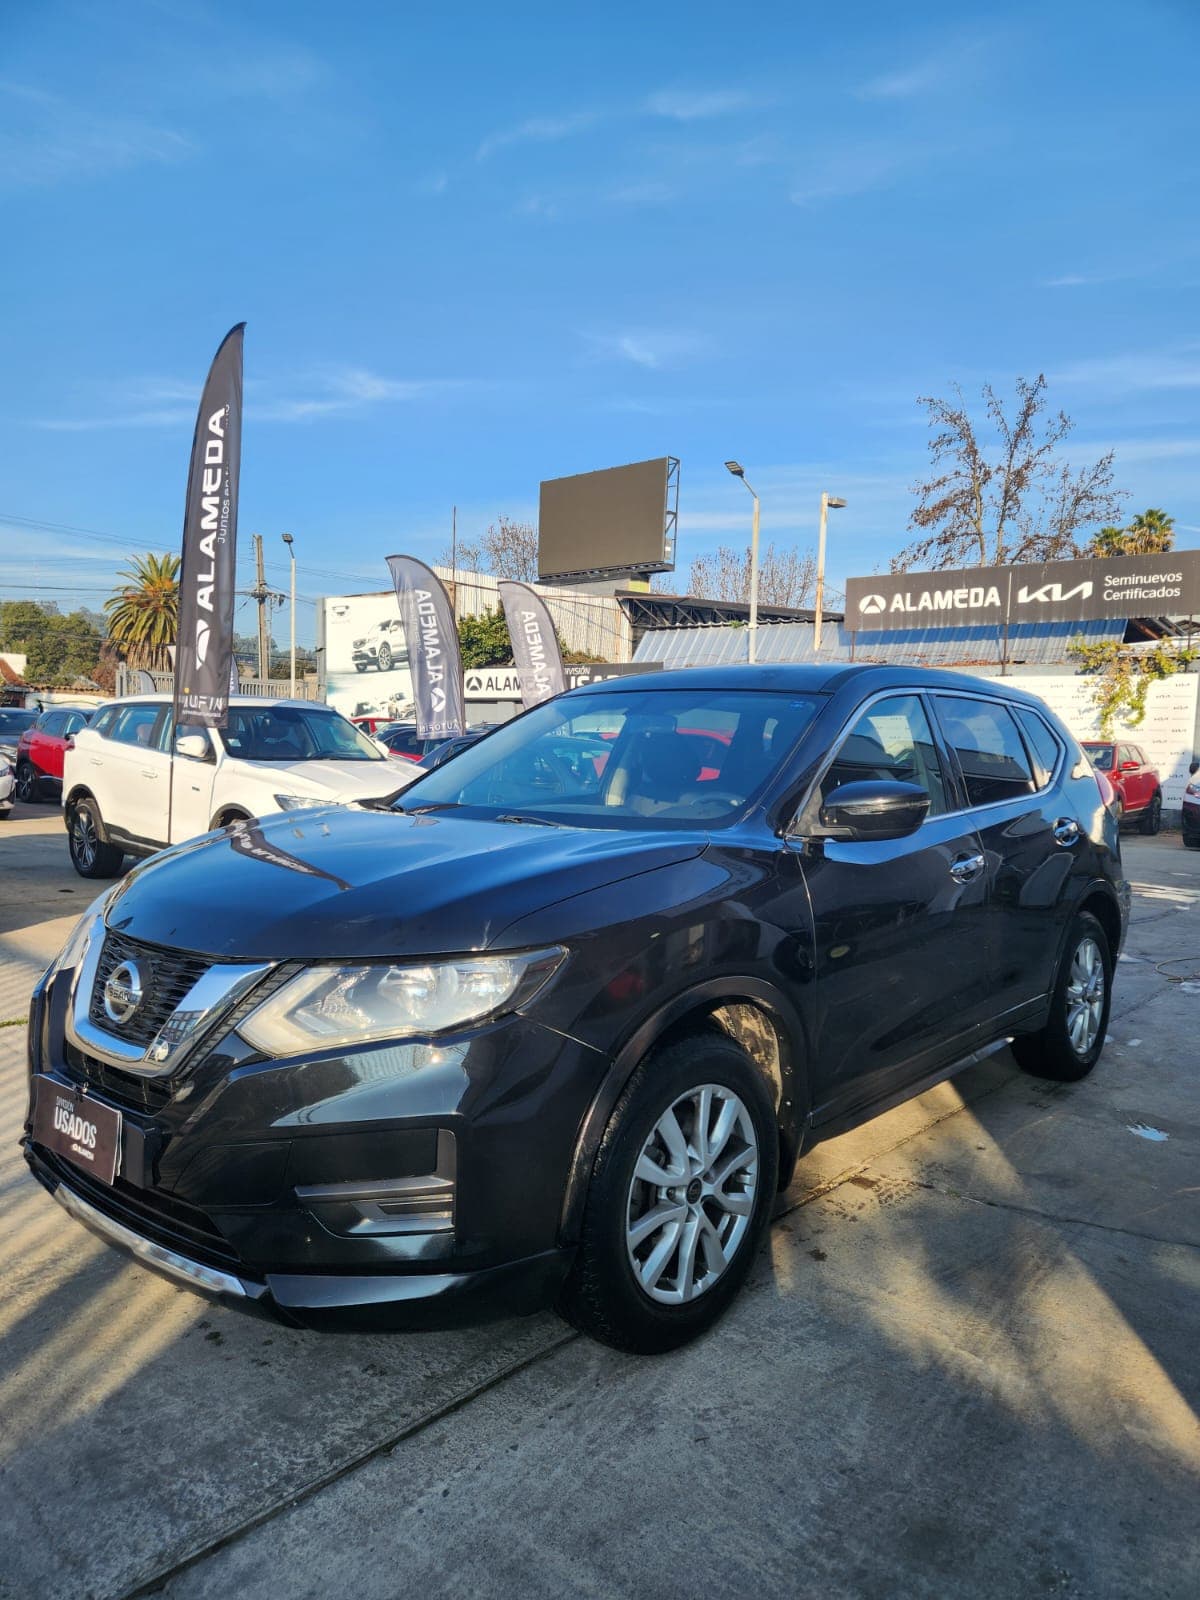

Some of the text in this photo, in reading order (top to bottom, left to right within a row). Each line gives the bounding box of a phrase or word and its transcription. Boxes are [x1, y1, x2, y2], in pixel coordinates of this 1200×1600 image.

[197, 408, 225, 612] ALAMEDA
[1104, 572, 1183, 587] Seminuevos
[889, 586, 1002, 613] ALAMEDA
[1018, 581, 1094, 604] KIA
[1103, 587, 1181, 602] Certificados
[54, 1106, 97, 1149] USADOS
